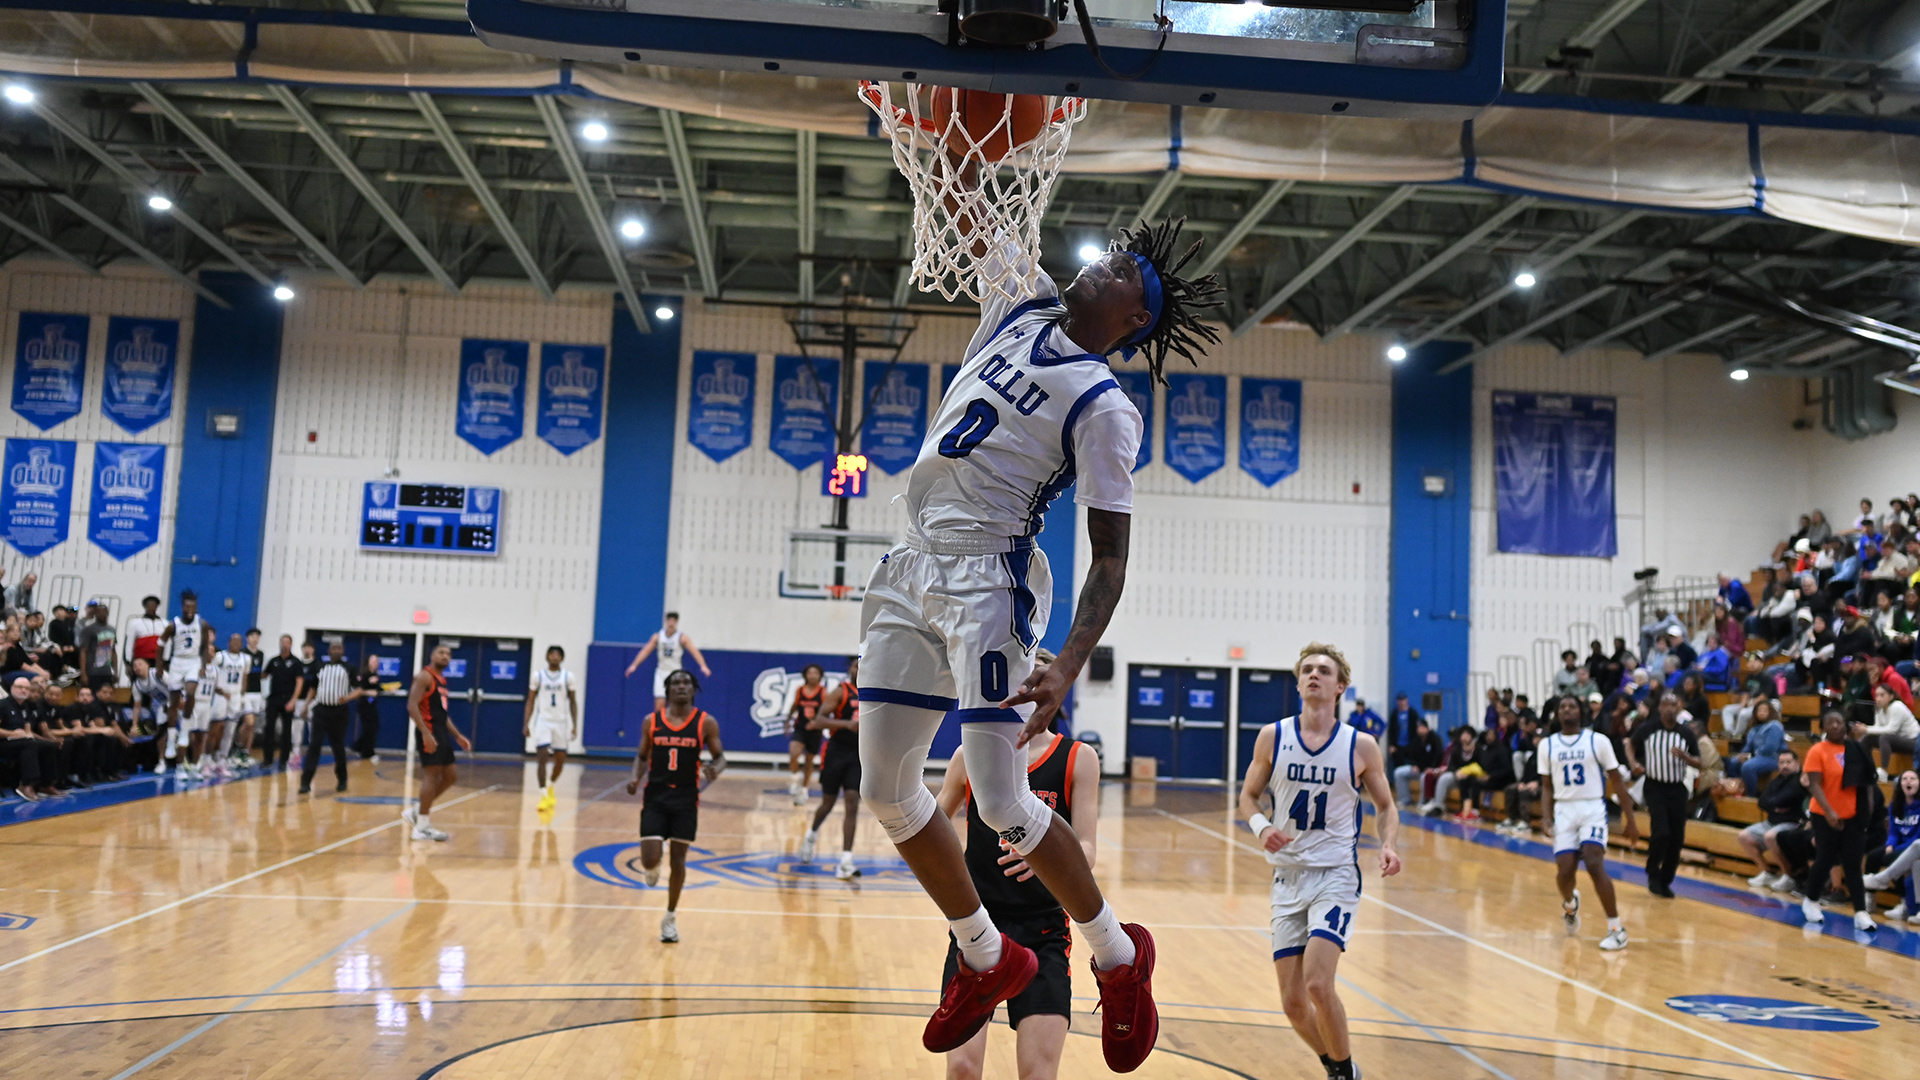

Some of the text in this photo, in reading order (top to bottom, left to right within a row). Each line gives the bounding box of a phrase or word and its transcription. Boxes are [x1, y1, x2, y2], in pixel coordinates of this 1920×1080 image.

[978, 354, 1050, 416] OLLU
[938, 398, 999, 459] 0
[11, 463, 64, 488] OLLU
[101, 466, 153, 490] OLLU
[829, 468, 860, 495] 27
[368, 508, 398, 520] HOME
[460, 513, 493, 525] GUEST
[980, 650, 1009, 702] 0
[551, 693, 556, 707] 1
[654, 736, 697, 748] WILDCATS
[668, 748, 678, 771] 1
[1558, 749, 1585, 762] OLLU
[1287, 763, 1336, 785] OLLU
[1563, 763, 1586, 786] 13
[1289, 789, 1329, 831] 41
[1325, 905, 1352, 937] 41
